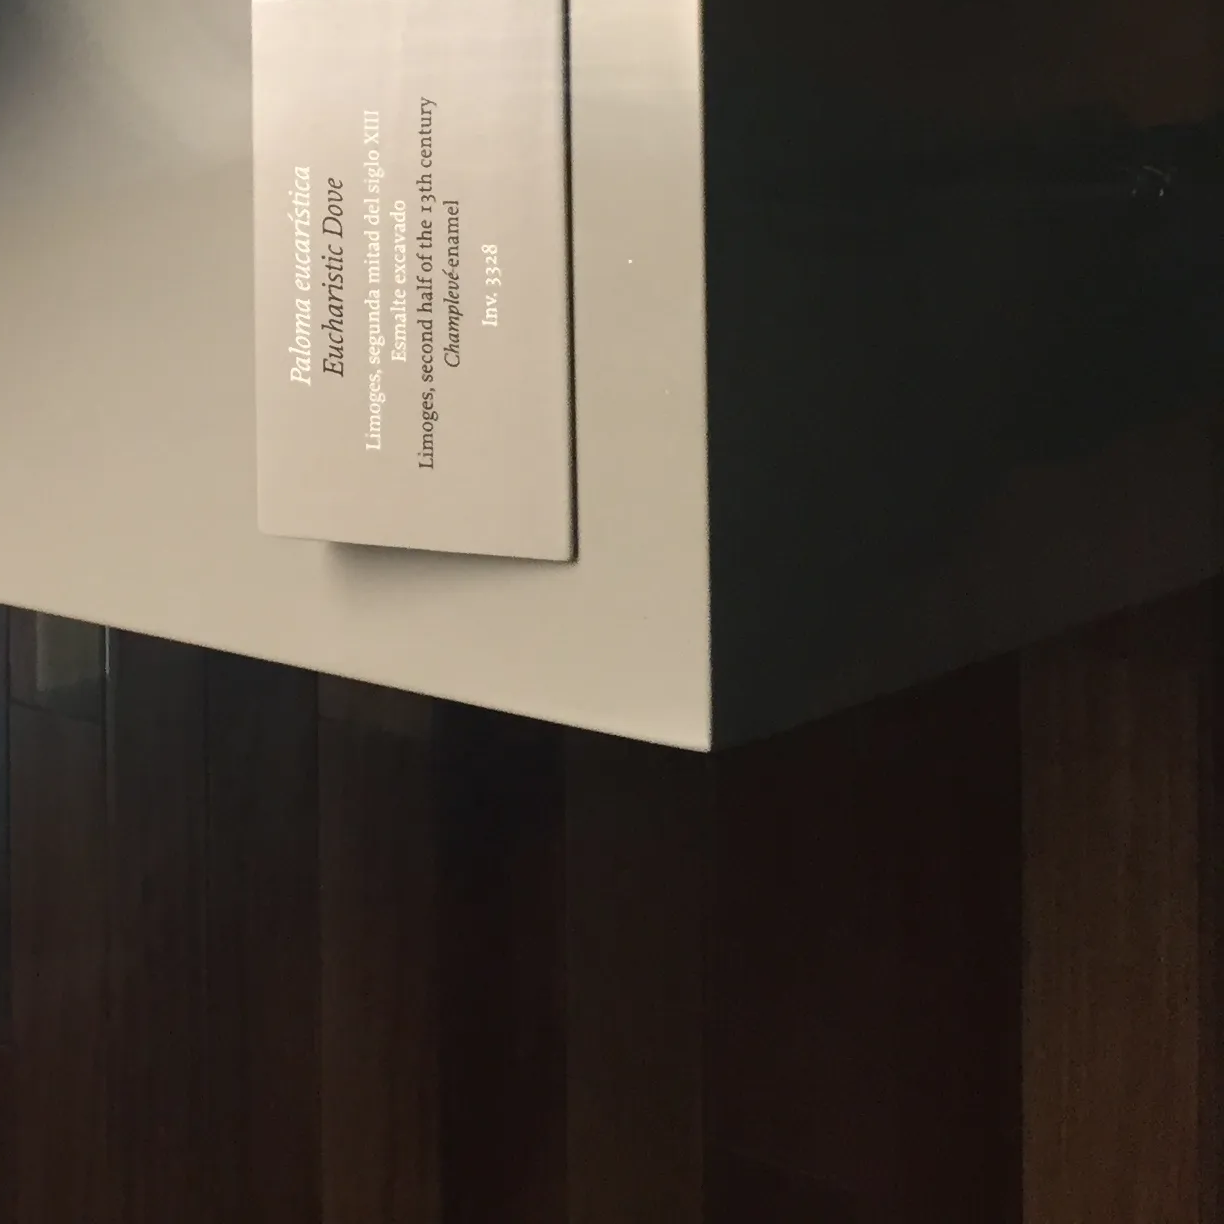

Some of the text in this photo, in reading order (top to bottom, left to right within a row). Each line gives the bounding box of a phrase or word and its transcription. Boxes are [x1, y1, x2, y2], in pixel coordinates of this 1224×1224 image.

[287, 167, 312, 386] Paloma eucarística
[320, 177, 345, 379] Eucharistic Dove
[364, 110, 386, 450] Limoges, segunda mitad del siglo XIII
[390, 200, 407, 362] Esmalte excavado
[416, 96, 439, 470] Limoges, second half of the 13th century
[481, 244, 501, 327] Inv. 3328
